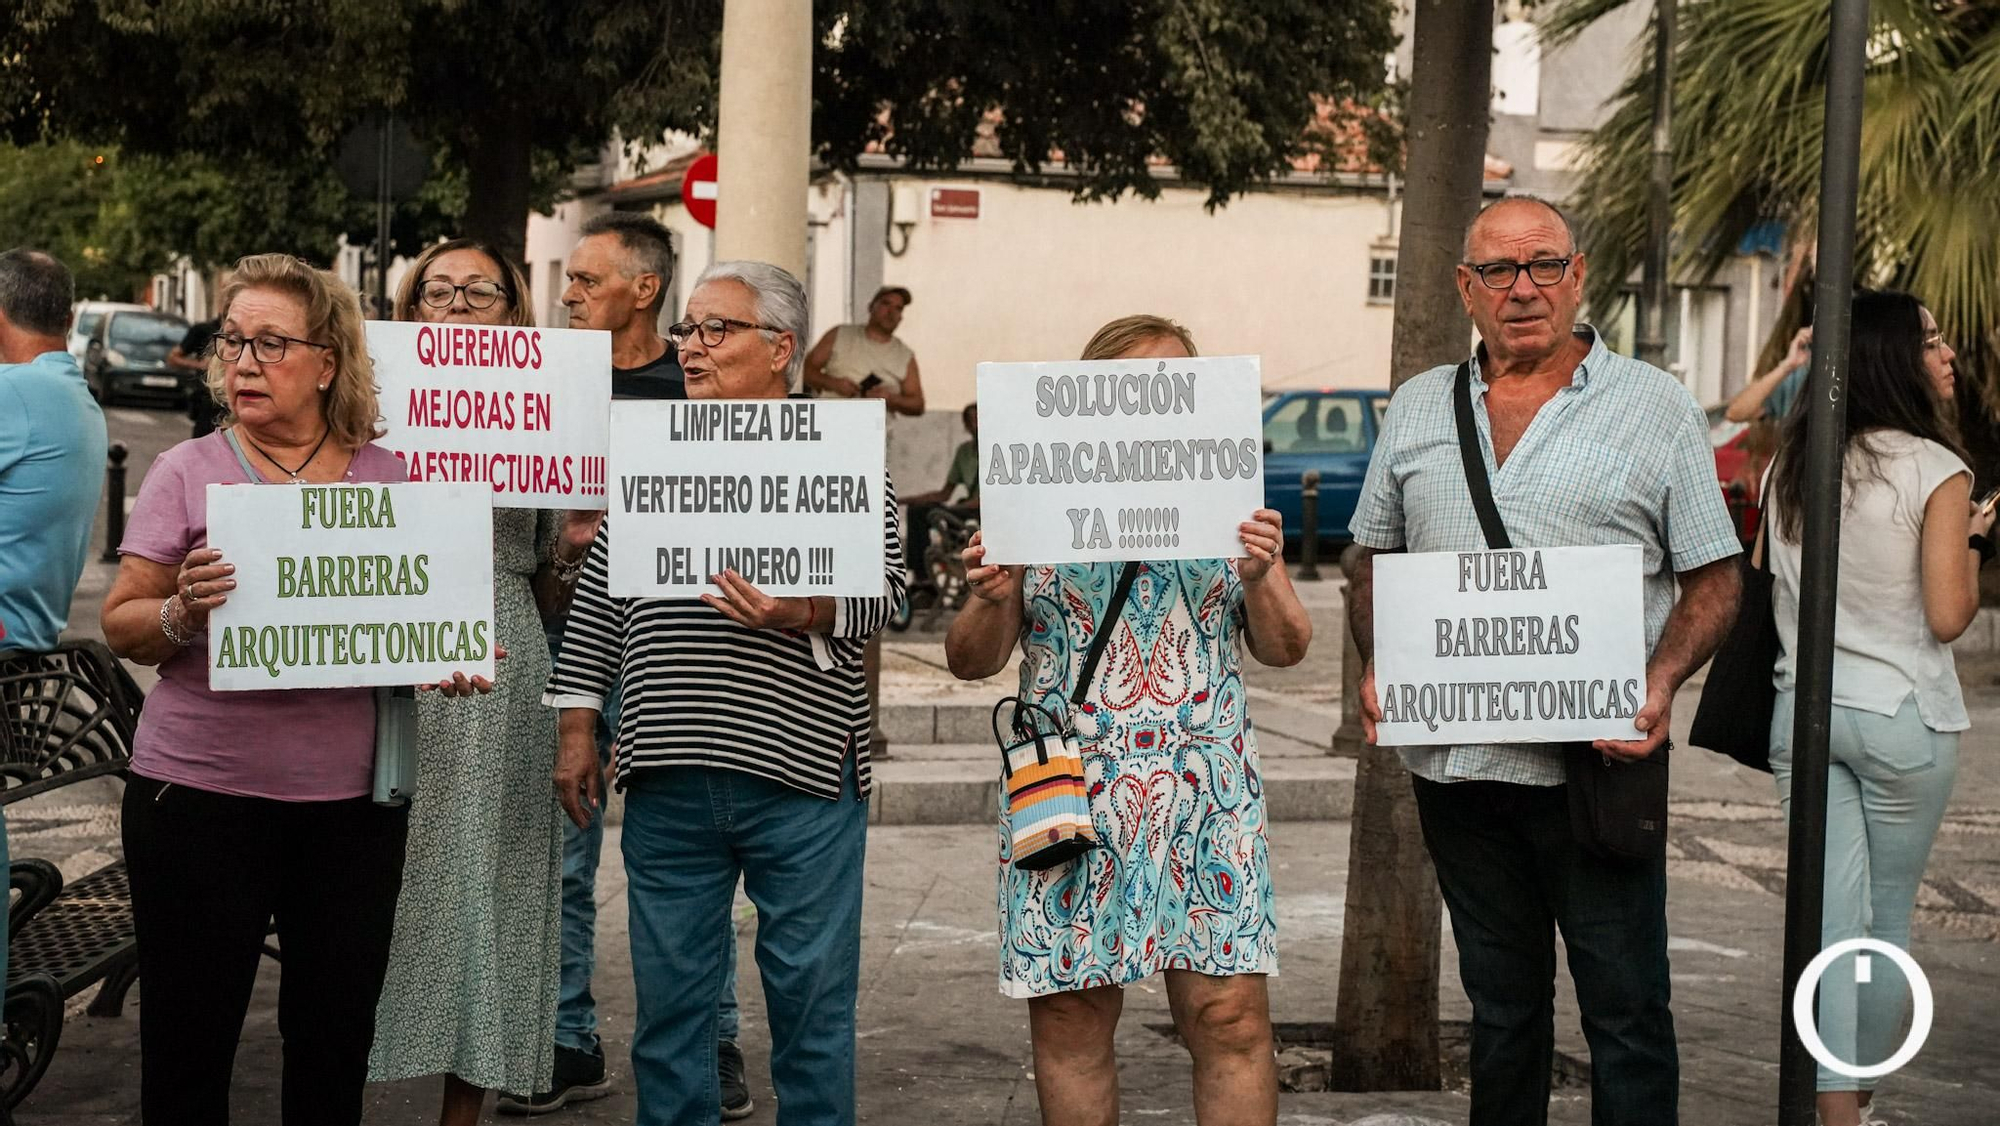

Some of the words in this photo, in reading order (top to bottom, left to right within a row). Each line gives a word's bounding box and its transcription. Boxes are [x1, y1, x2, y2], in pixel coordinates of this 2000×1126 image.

[417, 326, 542, 369] QUEREMOS
[408, 389, 515, 431] MEJORAS
[523, 393, 551, 431] EN
[1035, 361, 1196, 417] SOLUCIÓN
[670, 403, 773, 441] LIMPIEZA
[780, 403, 822, 441] DEL
[392, 450, 573, 495] AESTRUCTURAS
[985, 438, 1258, 485] APARCAMIENTOS
[301, 487, 396, 529] FUERA
[621, 475, 753, 514] VERTEDERO
[760, 475, 788, 513] DE
[795, 475, 870, 514] ACERA
[1066, 507, 1112, 549] YA
[277, 554, 429, 598] BARRERAS
[656, 547, 698, 585] DEL
[705, 547, 801, 585] LINDERO
[1458, 550, 1547, 592] FUERA
[216, 620, 488, 677] ARQUITECTONICAS
[1435, 615, 1579, 658] BARRERAS
[1380, 679, 1639, 732] ARQUITECTONICAS
